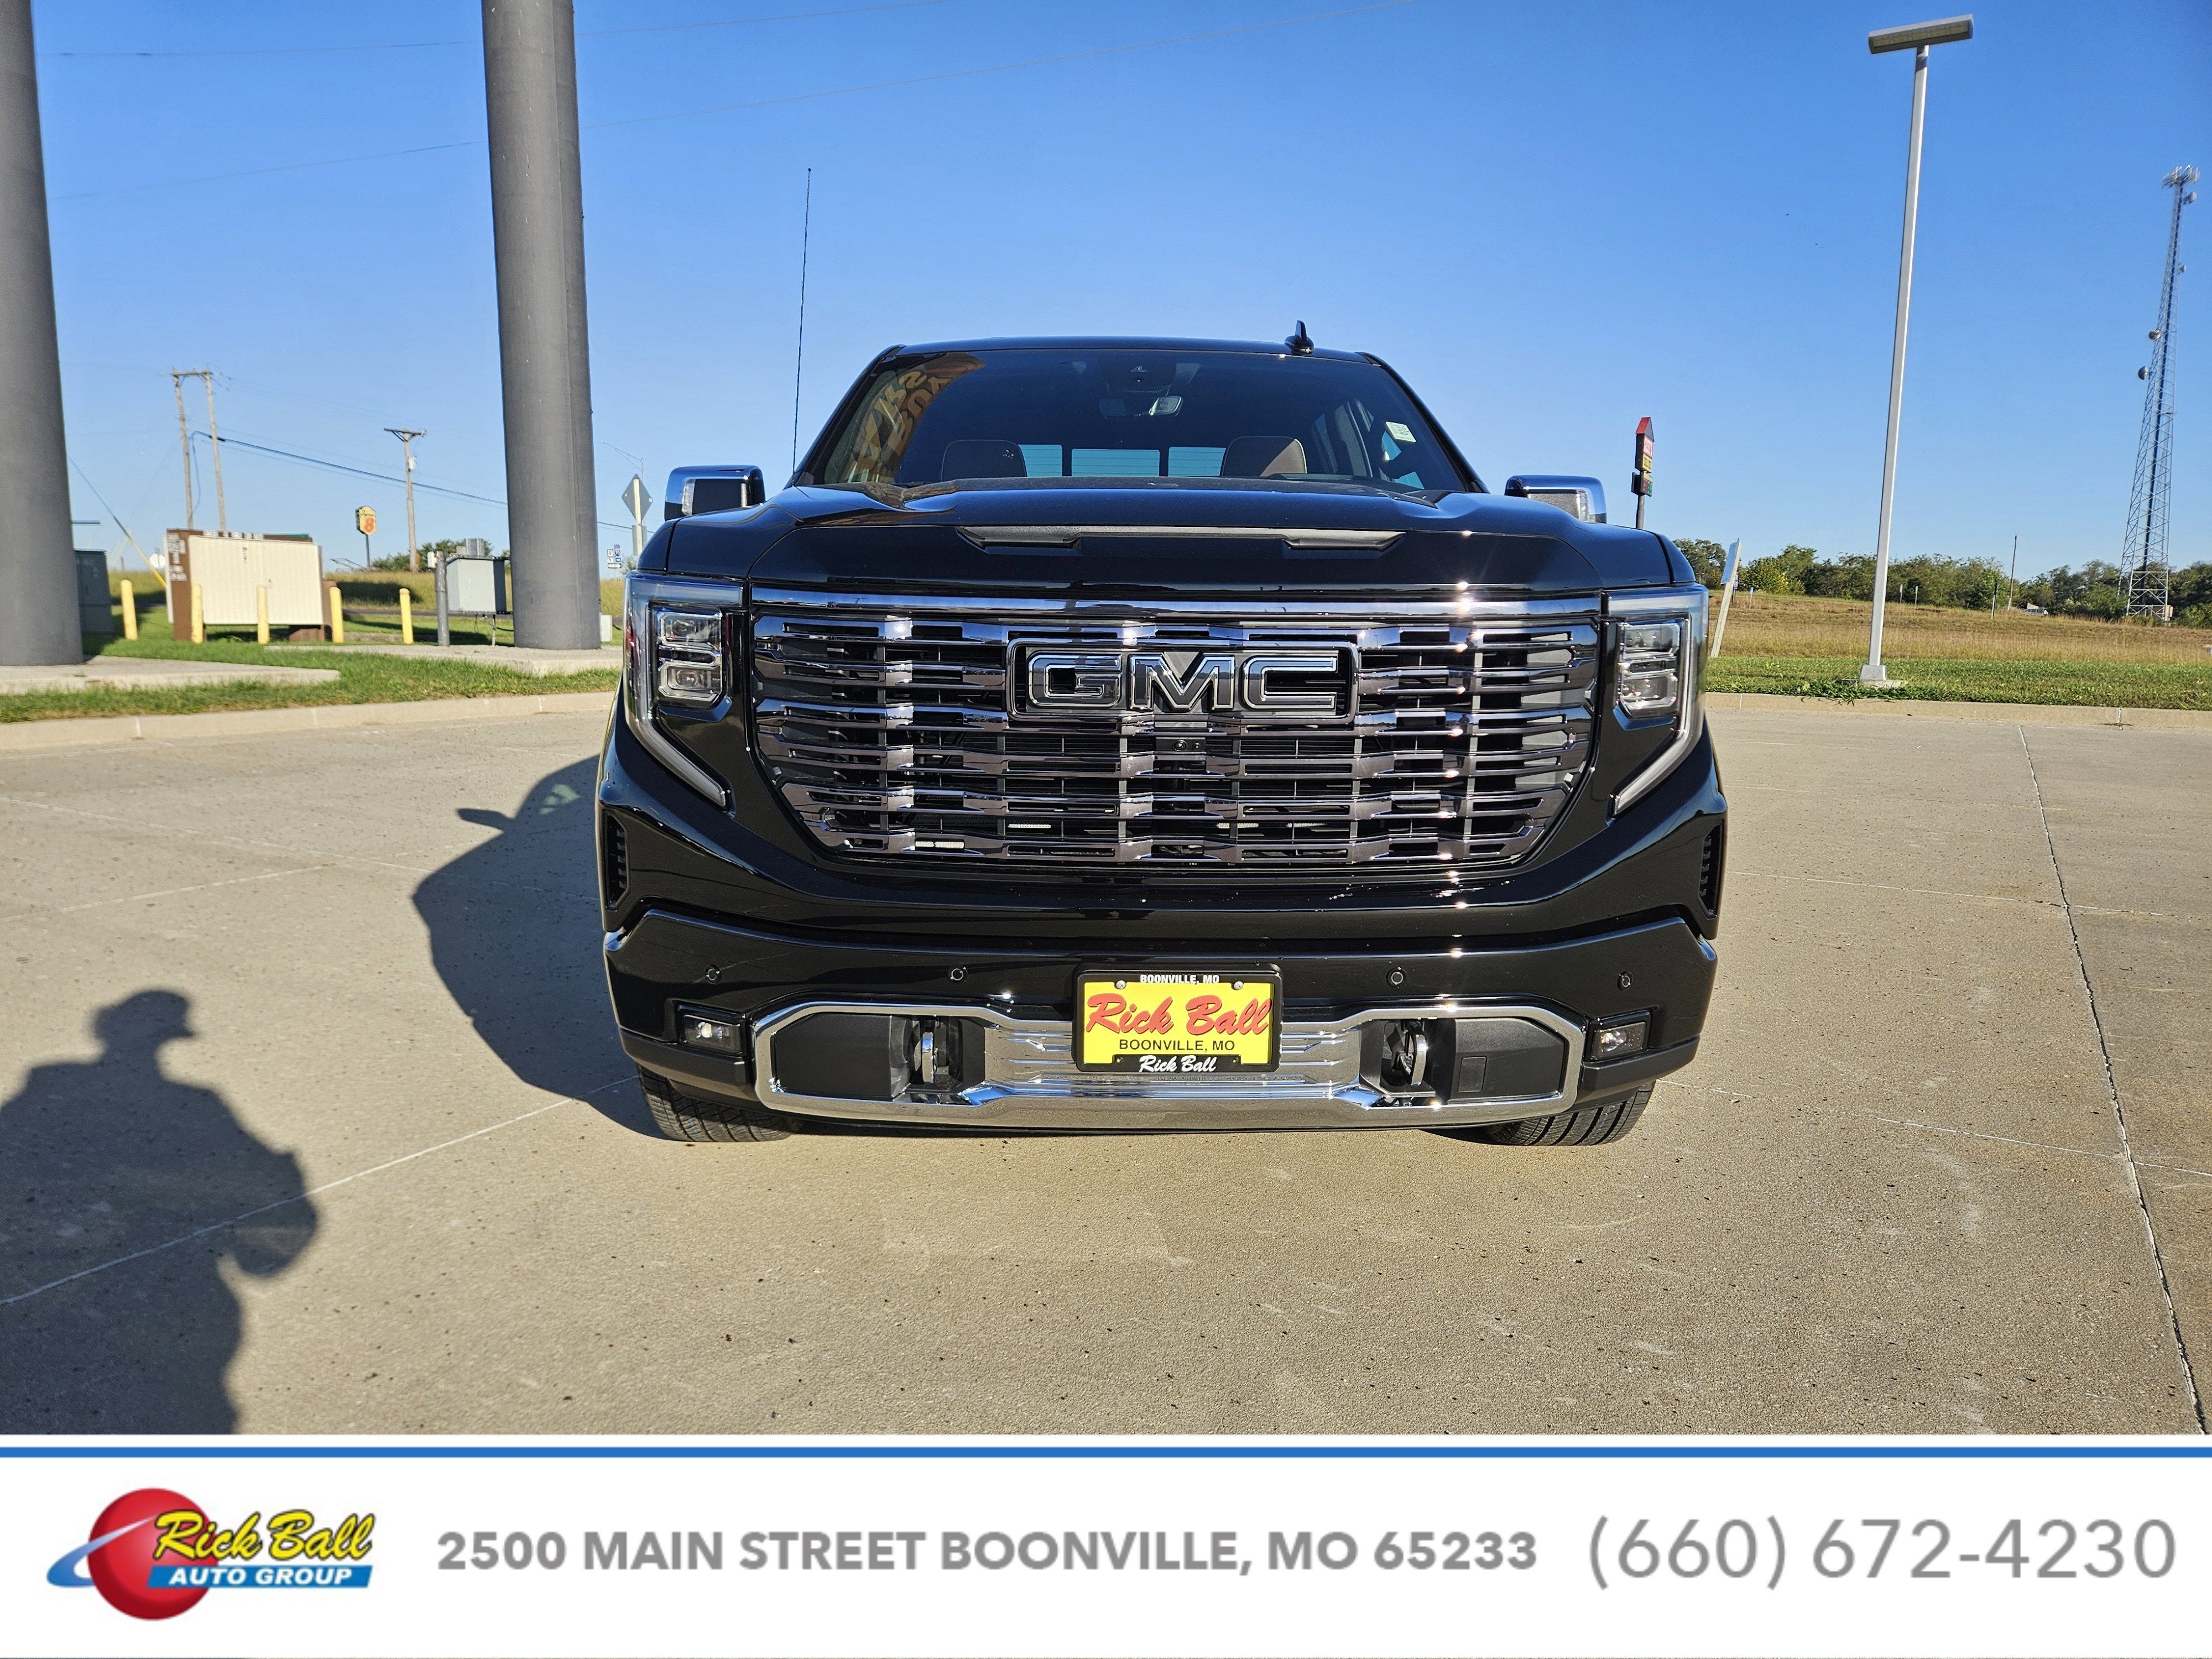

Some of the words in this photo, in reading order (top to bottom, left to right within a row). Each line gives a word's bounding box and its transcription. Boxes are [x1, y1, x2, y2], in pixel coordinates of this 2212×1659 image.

[364, 517, 374, 533] 8
[1028, 652, 1337, 710] GMC
[1140, 974, 1199, 985] BOONVILLE,
[1203, 974, 1220, 984] MO
[1086, 993, 1174, 1035] Rick
[1185, 994, 1272, 1036] Ball
[1119, 1039, 1207, 1053] BOONVILLE,
[1212, 1040, 1235, 1051] MO
[1139, 1055, 1178, 1072] Rick
[1180, 1056, 1217, 1072] Ball
